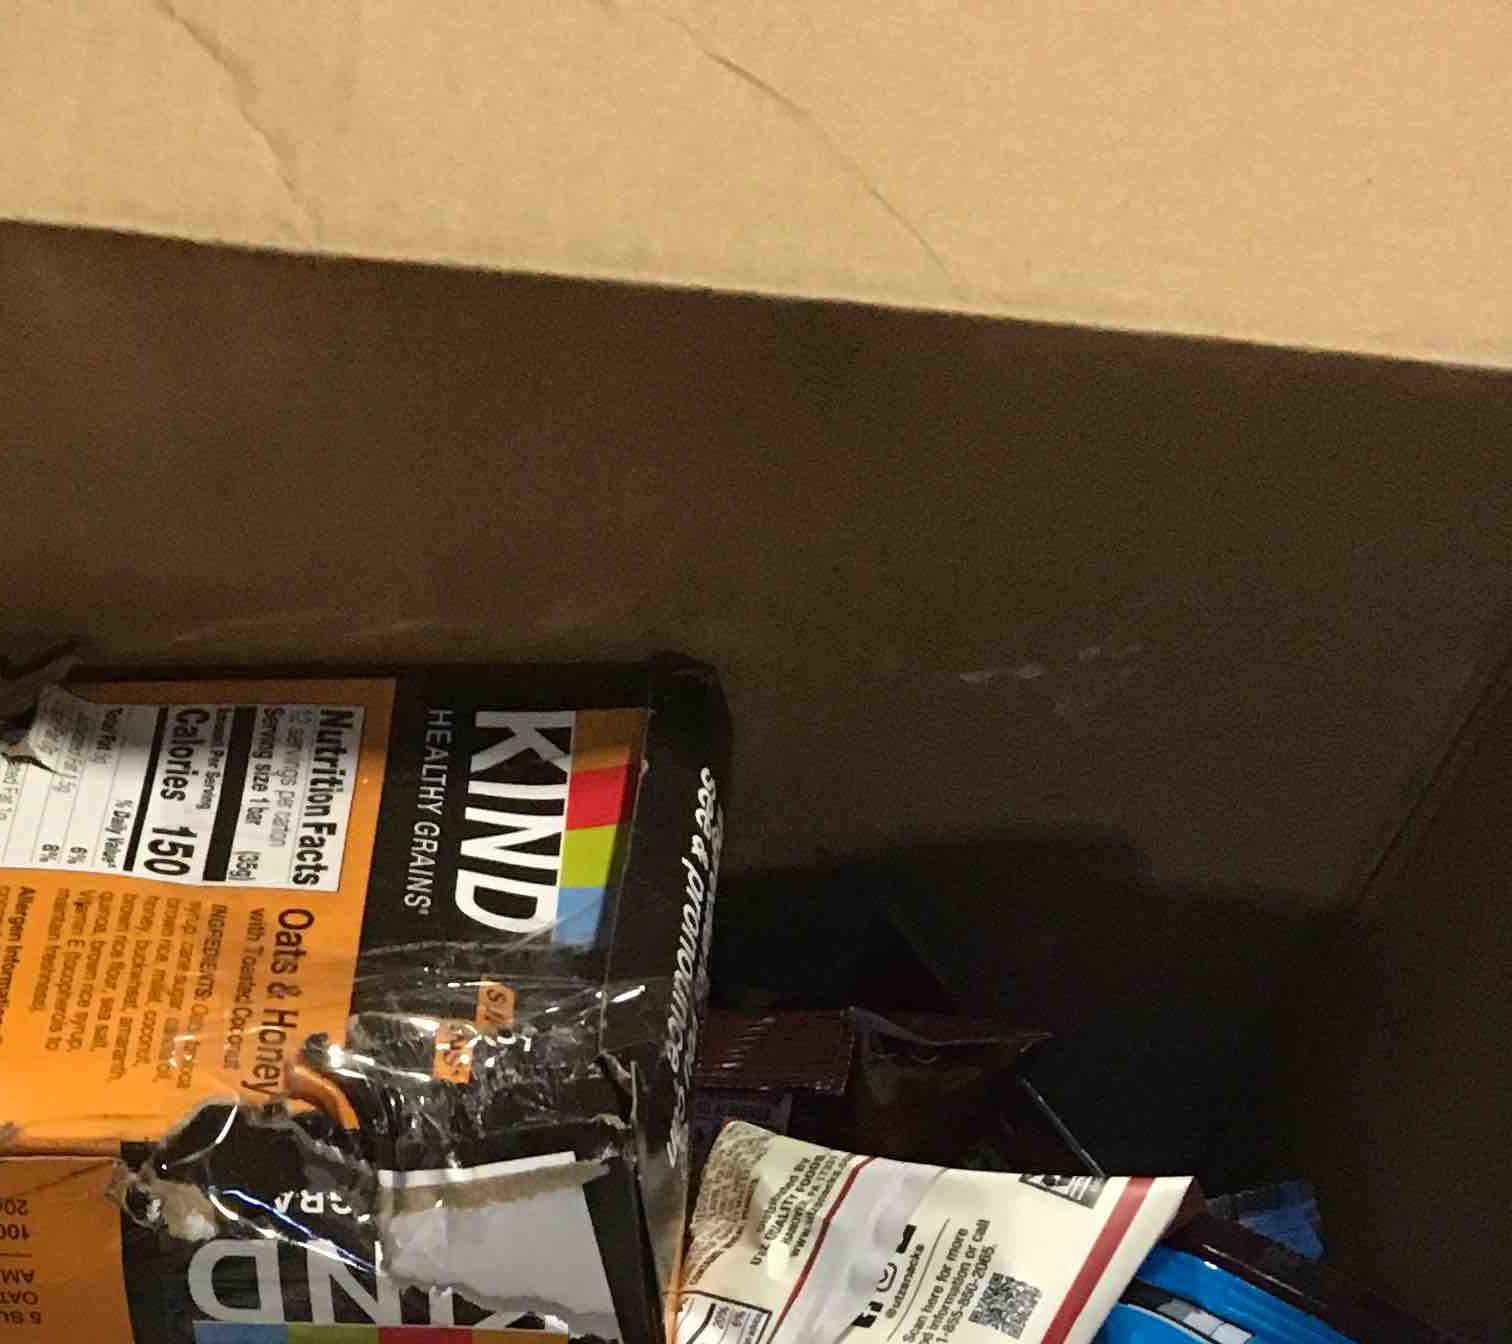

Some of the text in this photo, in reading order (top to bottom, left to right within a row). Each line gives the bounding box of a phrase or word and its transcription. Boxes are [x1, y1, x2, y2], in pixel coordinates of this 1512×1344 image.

[143, 702, 210, 878] Calories 150
[291, 705, 354, 888] Nutrition Facts
[400, 706, 454, 911] HEALTHY GRAINS
[459, 717, 575, 929] KIND
[239, 906, 314, 1099] Oats Honey
[665, 765, 723, 1072] see pronounce
[900, 1225, 971, 1344] Scan here more
[925, 1258, 972, 1332] information
